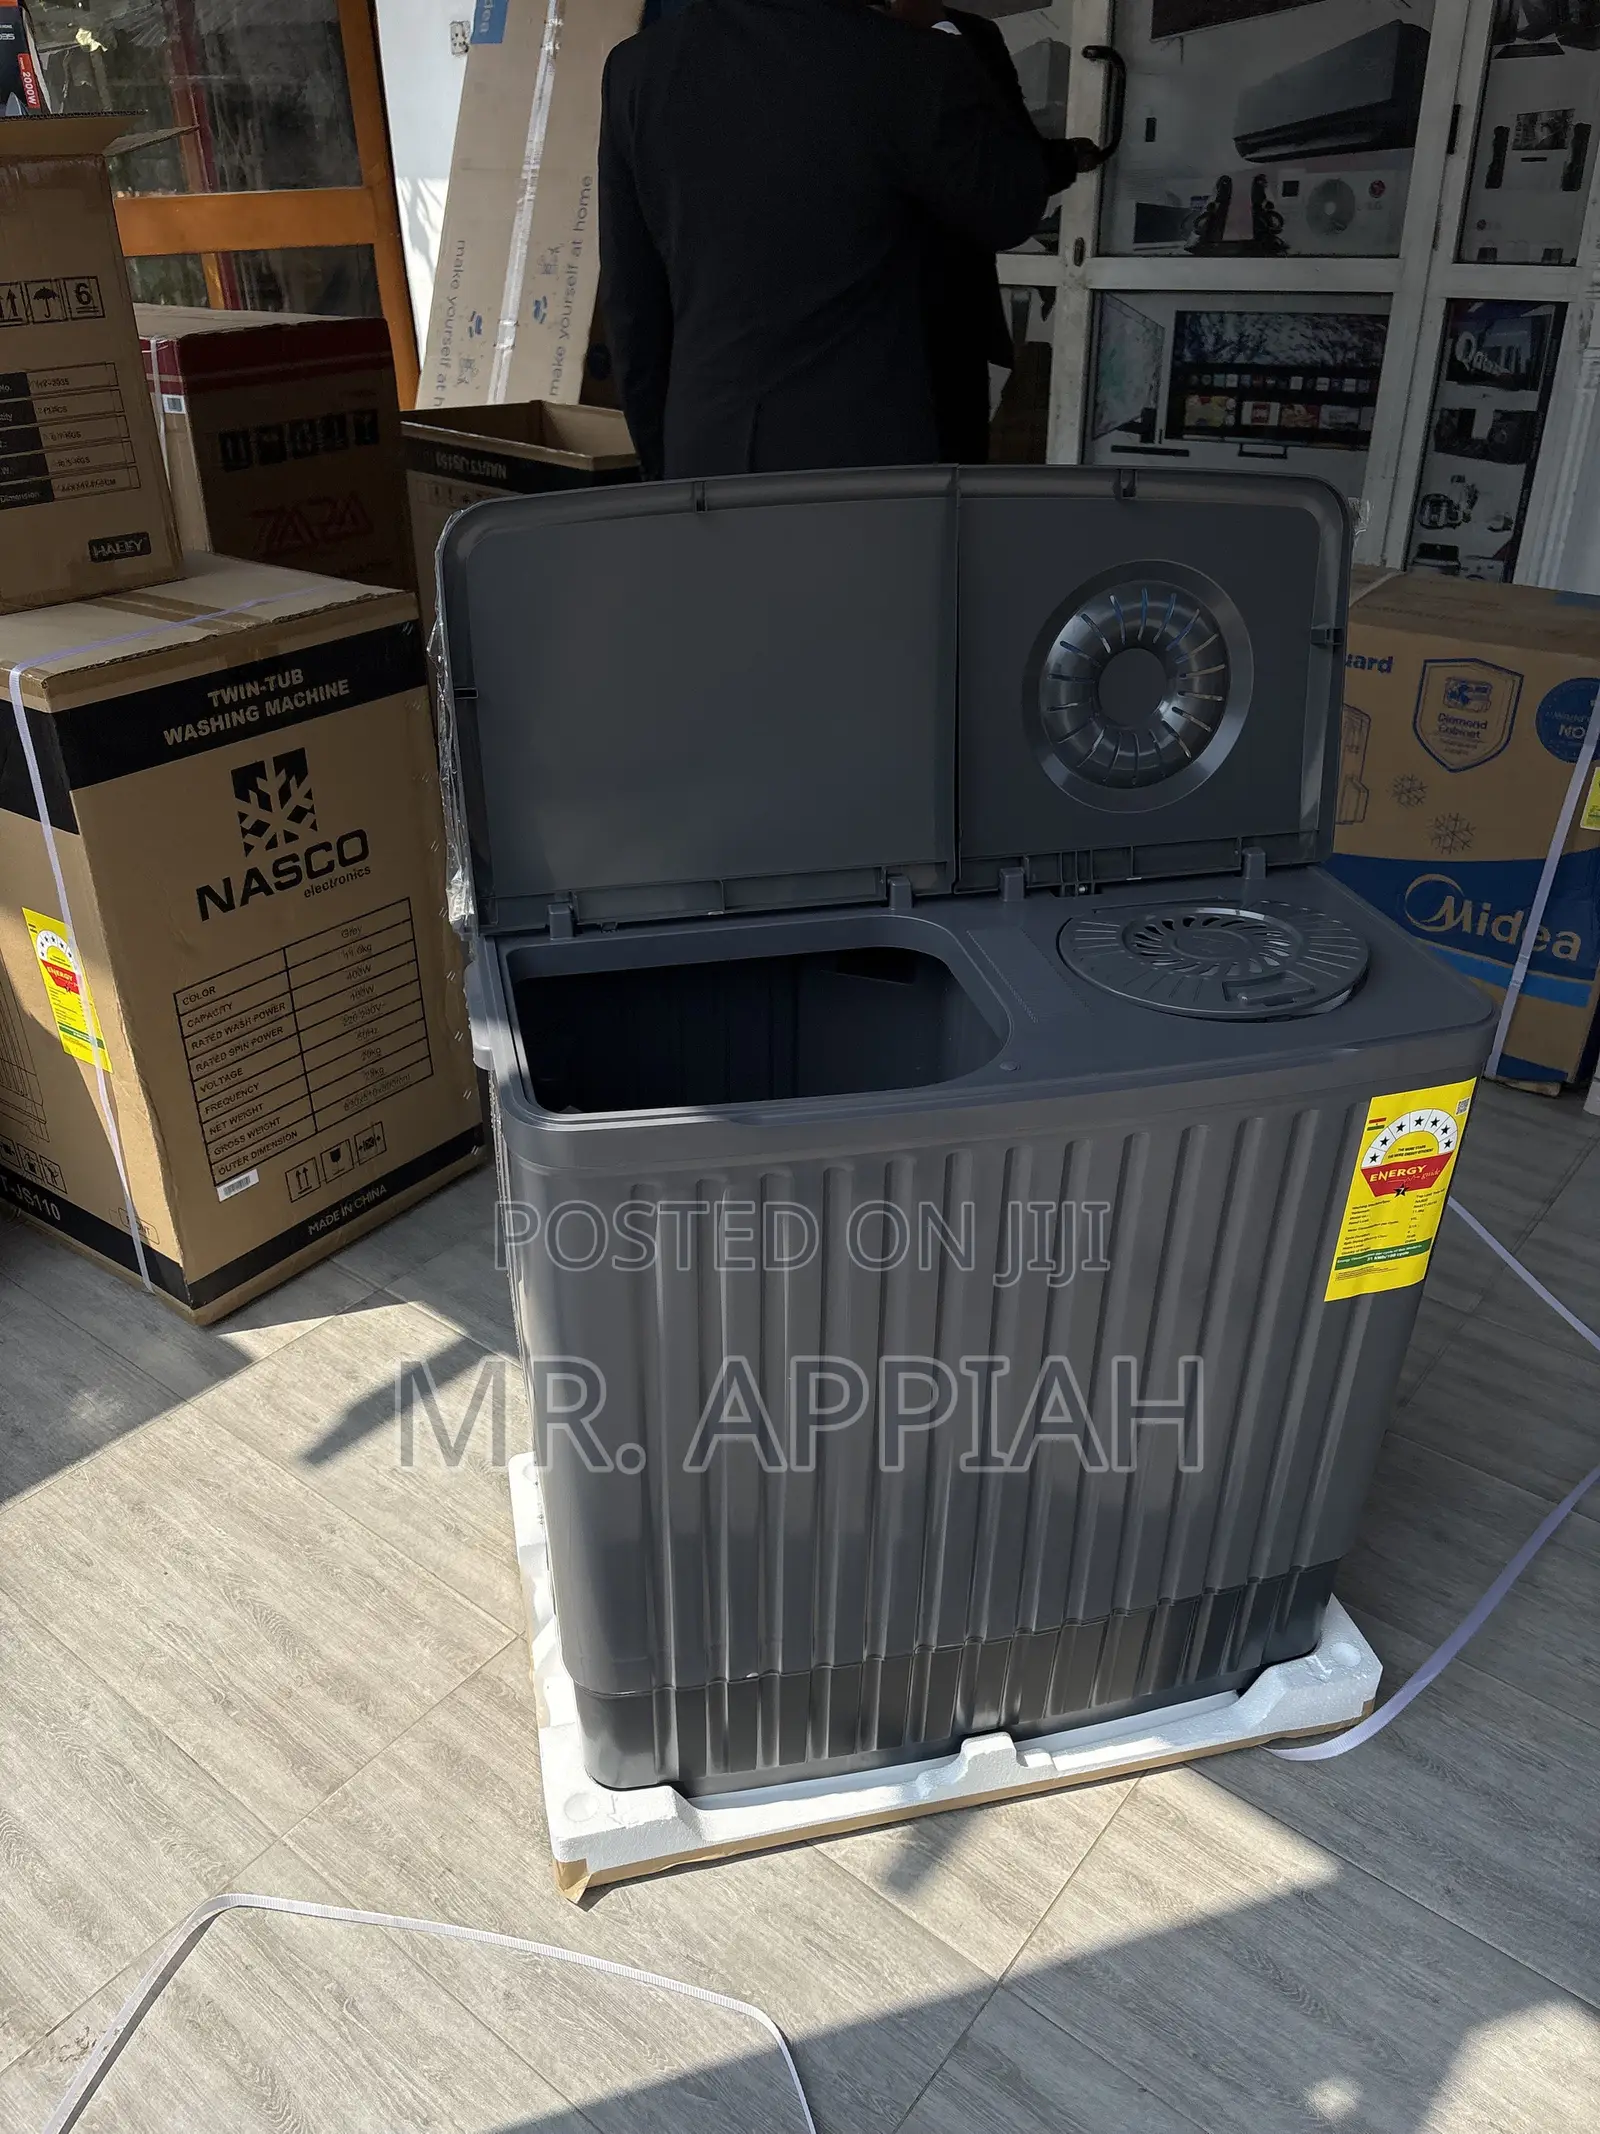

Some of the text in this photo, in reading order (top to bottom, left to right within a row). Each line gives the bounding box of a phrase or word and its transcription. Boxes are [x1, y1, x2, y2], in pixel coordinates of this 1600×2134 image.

[22, 71, 37, 105] 2000W
[449, 239, 466, 290] make
[75, 283, 92, 305] 6
[550, 175, 594, 396] make yourself at home
[438, 295, 458, 369] yourself
[207, 668, 304, 708] TWIN-TUB
[163, 679, 350, 746] WASHING MACHINE
[196, 829, 370, 922] NASCO
[303, 866, 372, 898] electronics
[182, 985, 216, 1006] COLOR
[186, 1002, 233, 1028] CAPACITY
[191, 1002, 286, 1050] RATED WASH POWER
[195, 1026, 284, 1072] RATED SPIN POWER
[199, 1067, 244, 1093] VOLTAGE
[204, 1082, 260, 1115] FREQUENCY
[209, 1103, 264, 1136] NET WEIGHT
[213, 1116, 281, 1156] GROSS WEIGHT
[218, 1130, 298, 1176] OUTER DIMENSION
[1369, 1164, 1428, 1183] ENERGY
[308, 1184, 388, 1236] MADE IN CHINA
